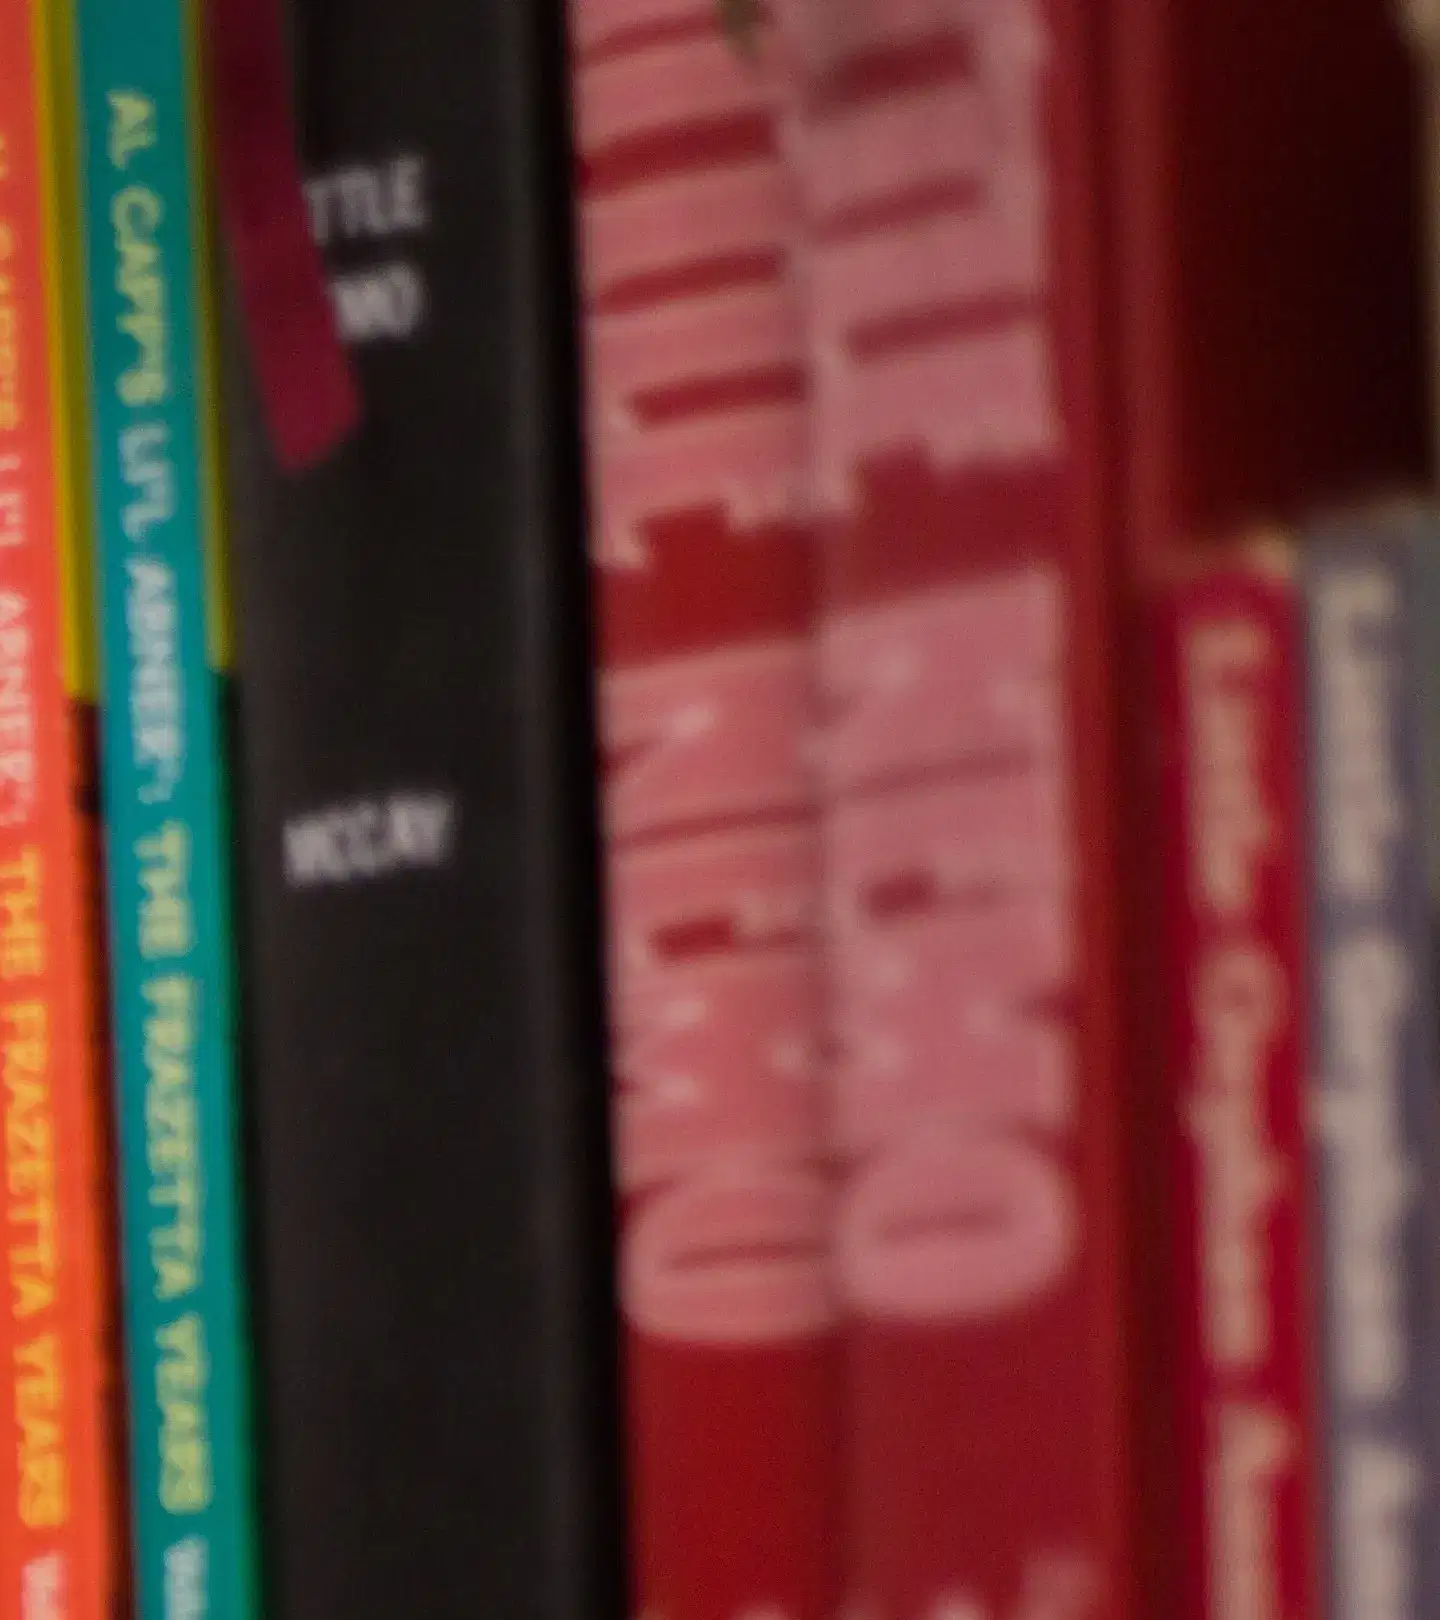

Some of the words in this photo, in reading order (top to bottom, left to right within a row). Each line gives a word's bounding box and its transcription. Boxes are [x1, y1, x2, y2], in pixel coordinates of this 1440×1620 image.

[106, 88, 156, 171] AL
[134, 818, 192, 962] THE
[0, 998, 60, 1323] FRAZETTA
[141, 971, 205, 1303] FRAZETTA
[12, 1331, 68, 1529] YEARS
[154, 1308, 212, 1515] YEARS
